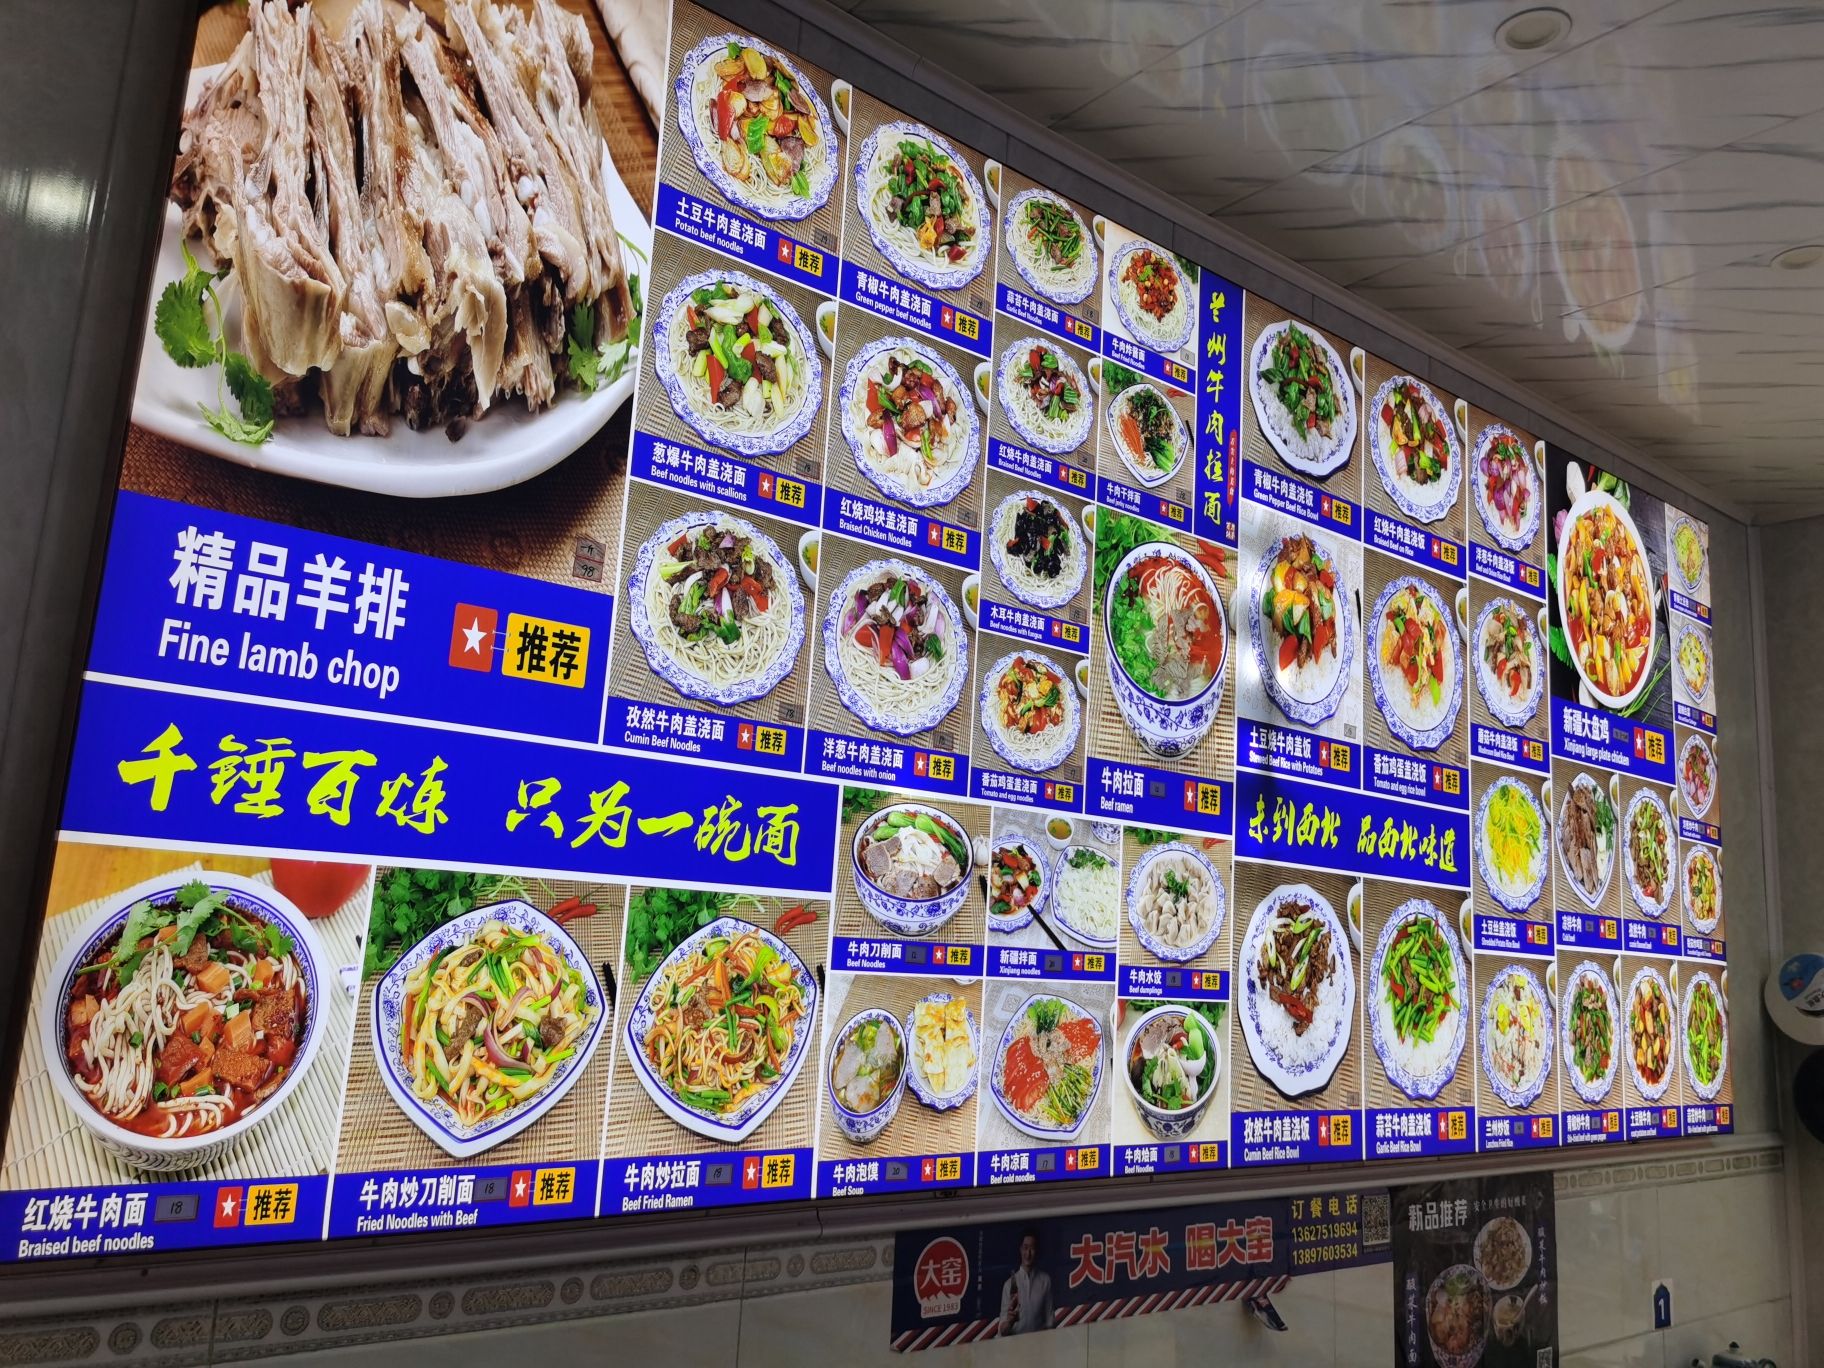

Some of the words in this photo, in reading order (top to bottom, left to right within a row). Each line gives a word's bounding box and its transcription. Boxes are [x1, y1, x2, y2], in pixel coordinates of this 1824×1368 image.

[676, 197, 767, 251] 土豆牛肉盖浇面
[674, 218, 699, 236] Potato
[700, 228, 716, 243] beef
[716, 237, 744, 255] noodles
[798, 249, 821, 273] 推荐
[856, 270, 932, 319] 青椒牛肉盖浇面
[855, 291, 874, 307] Green
[874, 299, 895, 316] pepper
[895, 306, 909, 319] beef
[909, 314, 932, 330] noodles
[1006, 290, 1059, 325] 蒜苔牛肉盖浇面
[958, 315, 977, 337] 推荐
[1077, 323, 1091, 339] 推荐
[1111, 338, 1146, 363] 牛肉炸酱面
[1204, 291, 1226, 525] 兰州牛肉拉面
[652, 441, 747, 488] 葱爆牛肉盖浇面
[998, 443, 1052, 474] 红烧牛肉盖浇面
[651, 464, 668, 480] Beef
[668, 472, 698, 488] noodles
[699, 480, 716, 493] with
[716, 484, 747, 502] scallions
[1070, 471, 1085, 487] 推荐
[1253, 468, 1314, 508] 青椒牛肉盖浇饭
[780, 481, 801, 505] 推荐
[1106, 482, 1141, 505] 牛肉干拌面
[1253, 488, 1269, 502] Green
[840, 496, 918, 537] 红烧鸡块盖浇面
[1335, 502, 1349, 522] 推荐
[839, 518, 862, 534] Braised
[863, 524, 887, 541] Chicken
[888, 532, 912, 548] Noodles
[945, 529, 965, 552] 推荐
[1374, 516, 1426, 550] 红烧牛肉盖浇饭
[581, 564, 595, 578] 98
[168, 525, 411, 641] 精品羊排
[990, 605, 1045, 632] 木耳牛肉盖浇面
[1000, 622, 1017, 634] noodles
[1064, 625, 1078, 641] 推荐
[158, 618, 230, 667] Fine
[239, 632, 318, 680] lamb
[328, 650, 400, 699] chop
[516, 621, 583, 682] 推荐
[626, 705, 726, 742] 孜然牛肉盖浇面
[1563, 705, 1610, 744] 新疆大盘鸡
[624, 731, 650, 746] Cumin
[651, 735, 669, 748] Beef
[670, 739, 701, 753] Noodles
[759, 728, 783, 752] 推荐
[1249, 725, 1312, 759] 土豆烧牛肉盖饭
[823, 737, 904, 769] 洋葱牛肉盖浇面
[1333, 746, 1348, 768] 推荐
[822, 760, 837, 772] Beef
[837, 764, 862, 776] noodles
[863, 768, 878, 778] with
[878, 771, 896, 781] onion
[932, 757, 952, 778] 推荐
[981, 772, 1038, 795] 番茄鸡蛋盖浇面
[1057, 786, 1071, 801] 推荐
[1101, 766, 1145, 798] 牛肉拉面
[118, 723, 450, 836] 千锤百炼
[505, 776, 799, 866] 只为一碗面
[981, 787, 998, 798] Tomato
[998, 792, 1008, 800] and
[1008, 794, 1017, 802] egg
[1016, 794, 1034, 803] noodles
[1100, 796, 1114, 812] Beef
[1115, 800, 1134, 814] ramen
[1201, 787, 1218, 812] 推荐
[848, 940, 902, 960] 牛肉刀削面
[950, 948, 968, 964] 推荐
[999, 949, 1038, 966] 新疆拌面
[847, 958, 860, 968] Beef
[861, 959, 886, 969] Noodles
[1087, 956, 1102, 970] 推荐
[1129, 968, 1162, 984] 牛肉水饺
[1204, 975, 1218, 989] 推荐
[1129, 985, 1140, 994] Beef
[1243, 1116, 1310, 1144] 孜然牛肉盖浇饭
[1334, 1119, 1349, 1143] 推荐
[990, 1152, 1030, 1173] 牛肉凉面
[1081, 1150, 1096, 1168] 推荐
[1124, 1147, 1158, 1164] 牛肉烩面
[1262, 1147, 1274, 1160] Beef
[624, 1160, 701, 1193] 牛肉炒拉面
[713, 1167, 723, 1179] 18
[766, 1158, 791, 1185] 推荐
[832, 1161, 879, 1184] 牛肉泡馍
[940, 1160, 958, 1178] 推荐
[990, 1174, 1003, 1185] Beef
[1003, 1174, 1014, 1184] cold
[1015, 1172, 1036, 1183] noodles
[1124, 1166, 1136, 1174] Beef
[359, 1174, 476, 1210] 牛肉炒刀削面
[484, 1182, 495, 1195] 18
[540, 1171, 571, 1201] 推荐
[832, 1186, 847, 1197] Beef
[21, 1192, 149, 1233] 红烧牛肉面
[169, 1200, 183, 1215] 18
[253, 1188, 292, 1221] 推荐
[622, 1196, 642, 1212] Beef
[643, 1194, 665, 1210] Fried
[666, 1194, 694, 1208] Ramen
[1292, 1194, 1358, 1220] 订餐电话
[357, 1215, 384, 1233] Fried
[386, 1212, 429, 1230] Noodles
[431, 1210, 453, 1228] with
[455, 1208, 478, 1226] Beef
[1408, 1198, 1468, 1232] 新品推荐
[1291, 1221, 1358, 1243] 13627519694
[18, 1238, 68, 1258] Braised
[71, 1235, 101, 1254] beef
[104, 1232, 154, 1252] noodles
[1068, 1226, 1171, 1288] 大汽水
[1184, 1216, 1274, 1271] 喝大窑
[1292, 1242, 1358, 1265] 13897603534
[919, 1256, 962, 1290] 大窑
[923, 1303, 942, 1316] SINCE
[943, 1301, 959, 1312] 1983
[1658, 1298, 1665, 1320] 1
